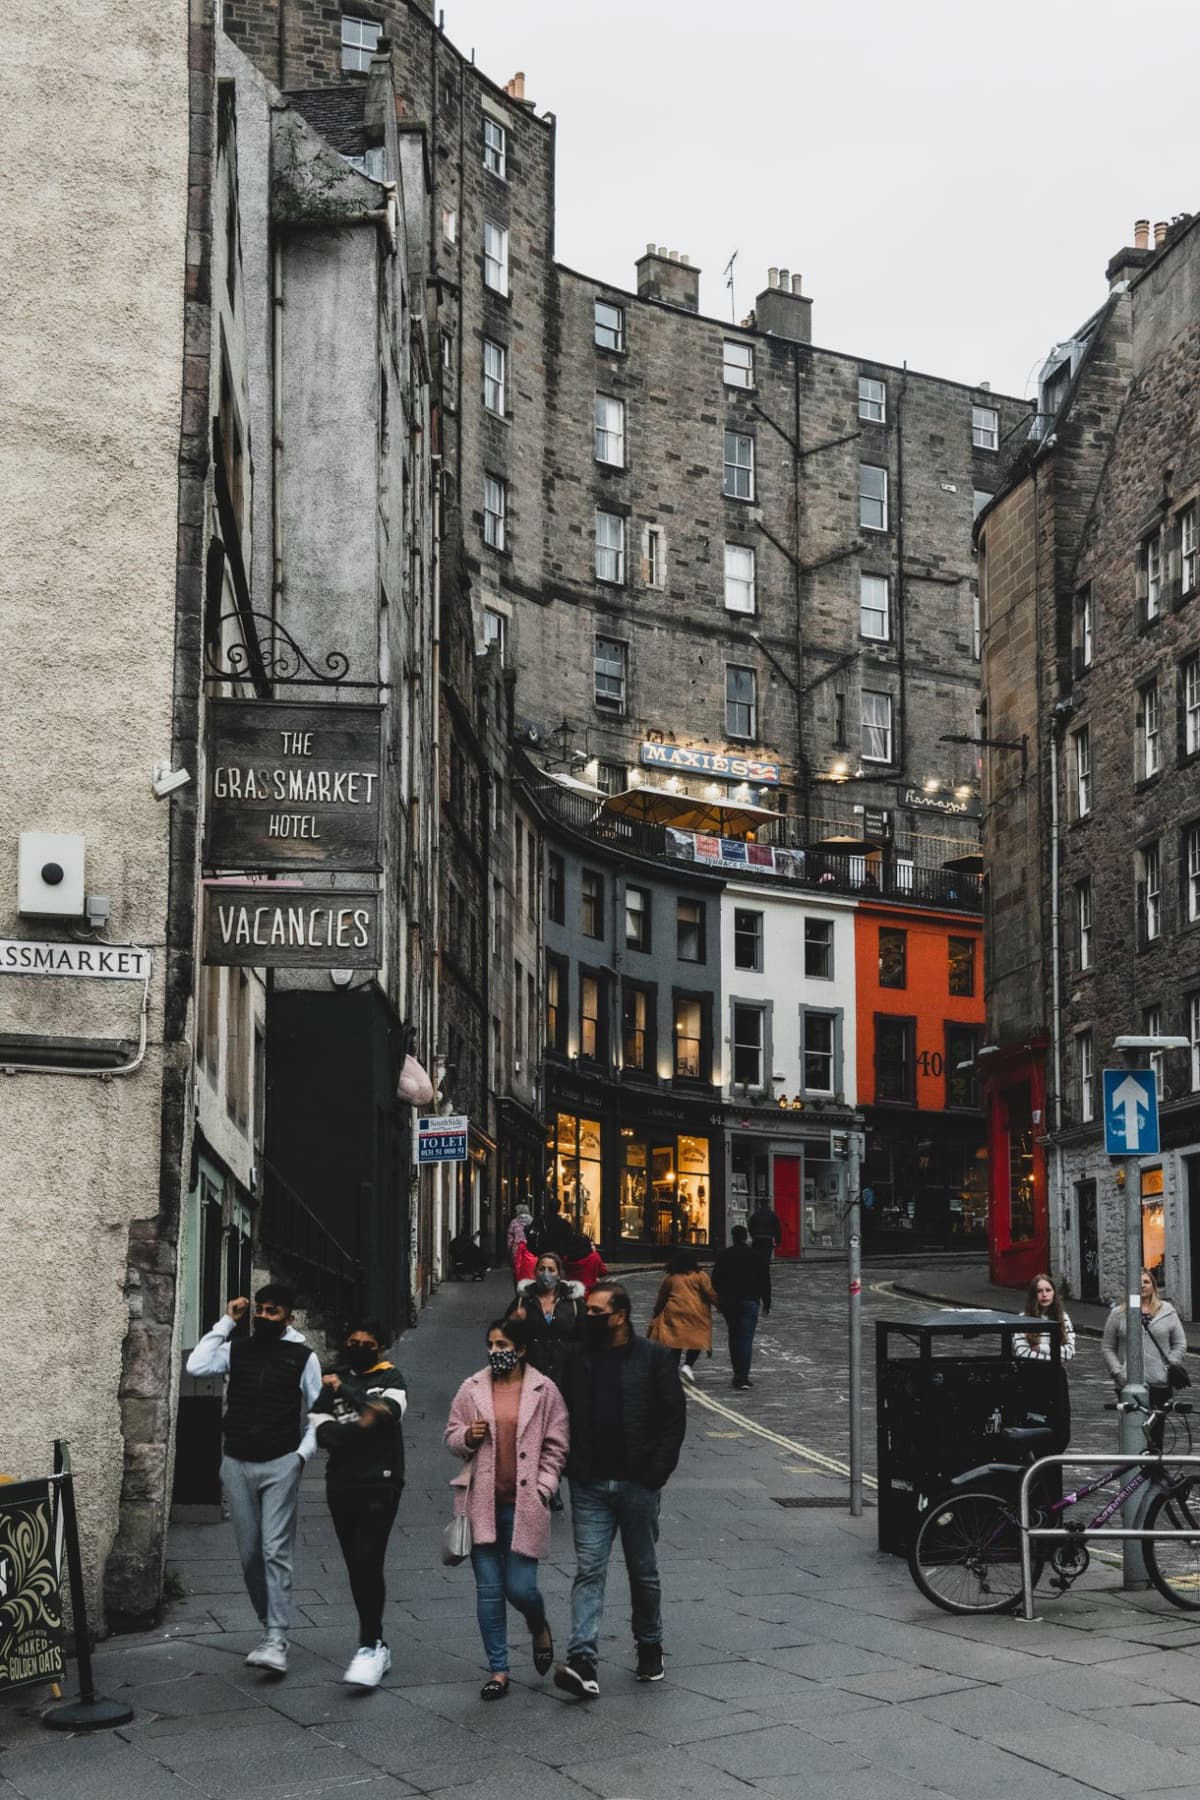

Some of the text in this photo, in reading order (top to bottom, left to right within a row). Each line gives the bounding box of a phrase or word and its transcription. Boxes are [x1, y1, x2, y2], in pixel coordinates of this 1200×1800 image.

[280, 731, 315, 756] THE
[647, 745, 749, 776] MAXIES
[214, 767, 378, 804] GRASSMARKET
[268, 814, 321, 839] HOTEL
[218, 905, 369, 947] VACANCIES
[0, 946, 144, 974] SSMARKET
[917, 1050, 942, 1077] 40
[420, 1136, 464, 1148] TO LET
[17, 1638, 48, 1656] NAKED
[9, 1646, 62, 1681] GOLDEN OATS
